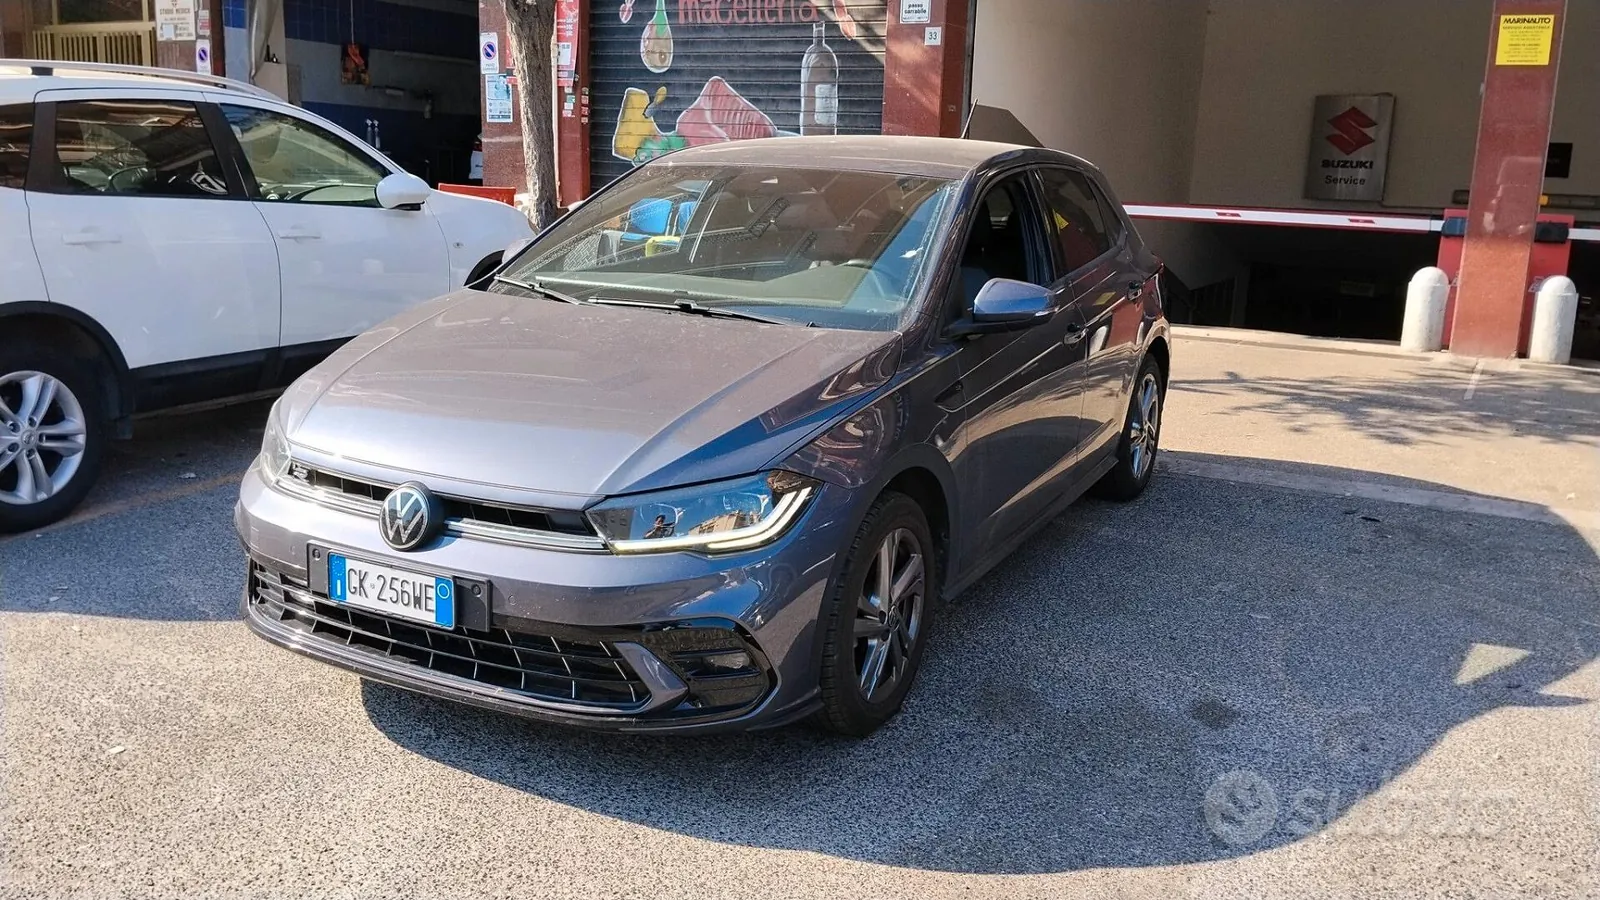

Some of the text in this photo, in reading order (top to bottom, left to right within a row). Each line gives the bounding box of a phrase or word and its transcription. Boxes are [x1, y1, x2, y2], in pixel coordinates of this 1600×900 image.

[678, 0, 820, 24] macelleria
[928, 31, 938, 40] 33
[1321, 160, 1374, 169] SUZUKI
[1324, 175, 1366, 186] Service
